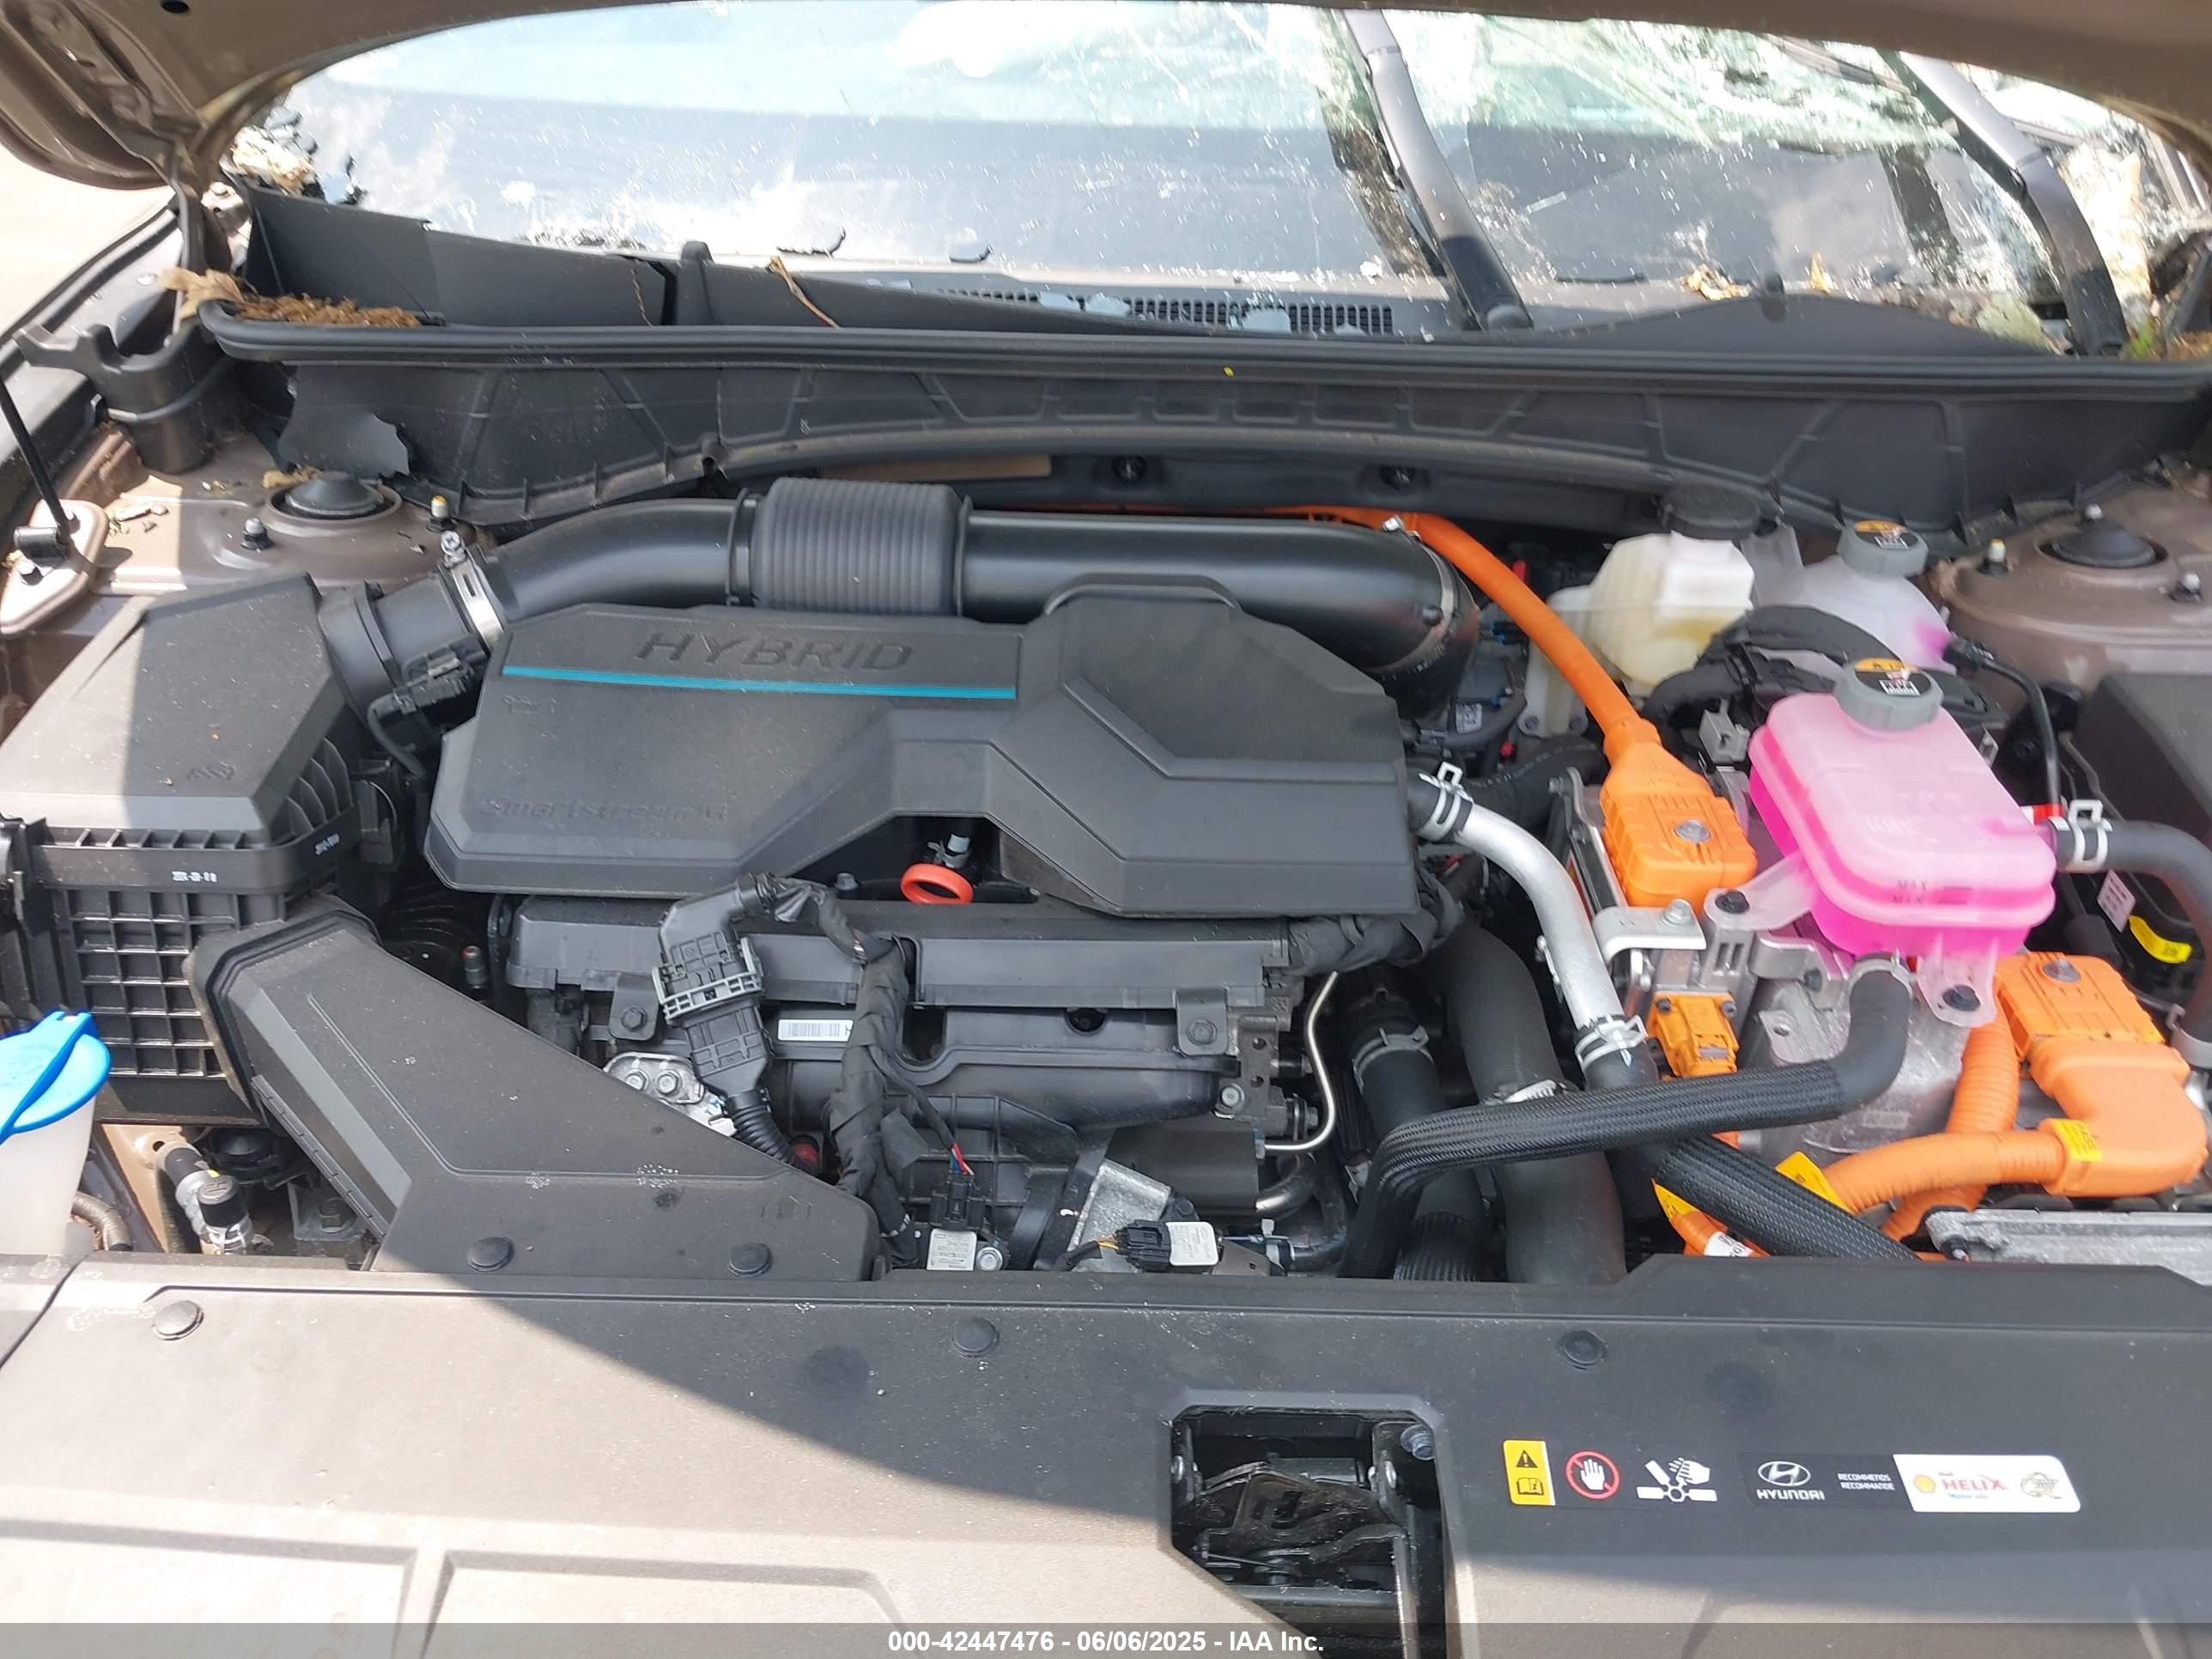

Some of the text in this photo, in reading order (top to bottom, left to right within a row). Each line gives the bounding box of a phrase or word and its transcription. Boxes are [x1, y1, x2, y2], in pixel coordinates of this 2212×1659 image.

[634, 631, 913, 670] HYBRID
[1941, 1475, 2008, 1492] HELIX
[1756, 1489, 1826, 1500] HYUNDAI
